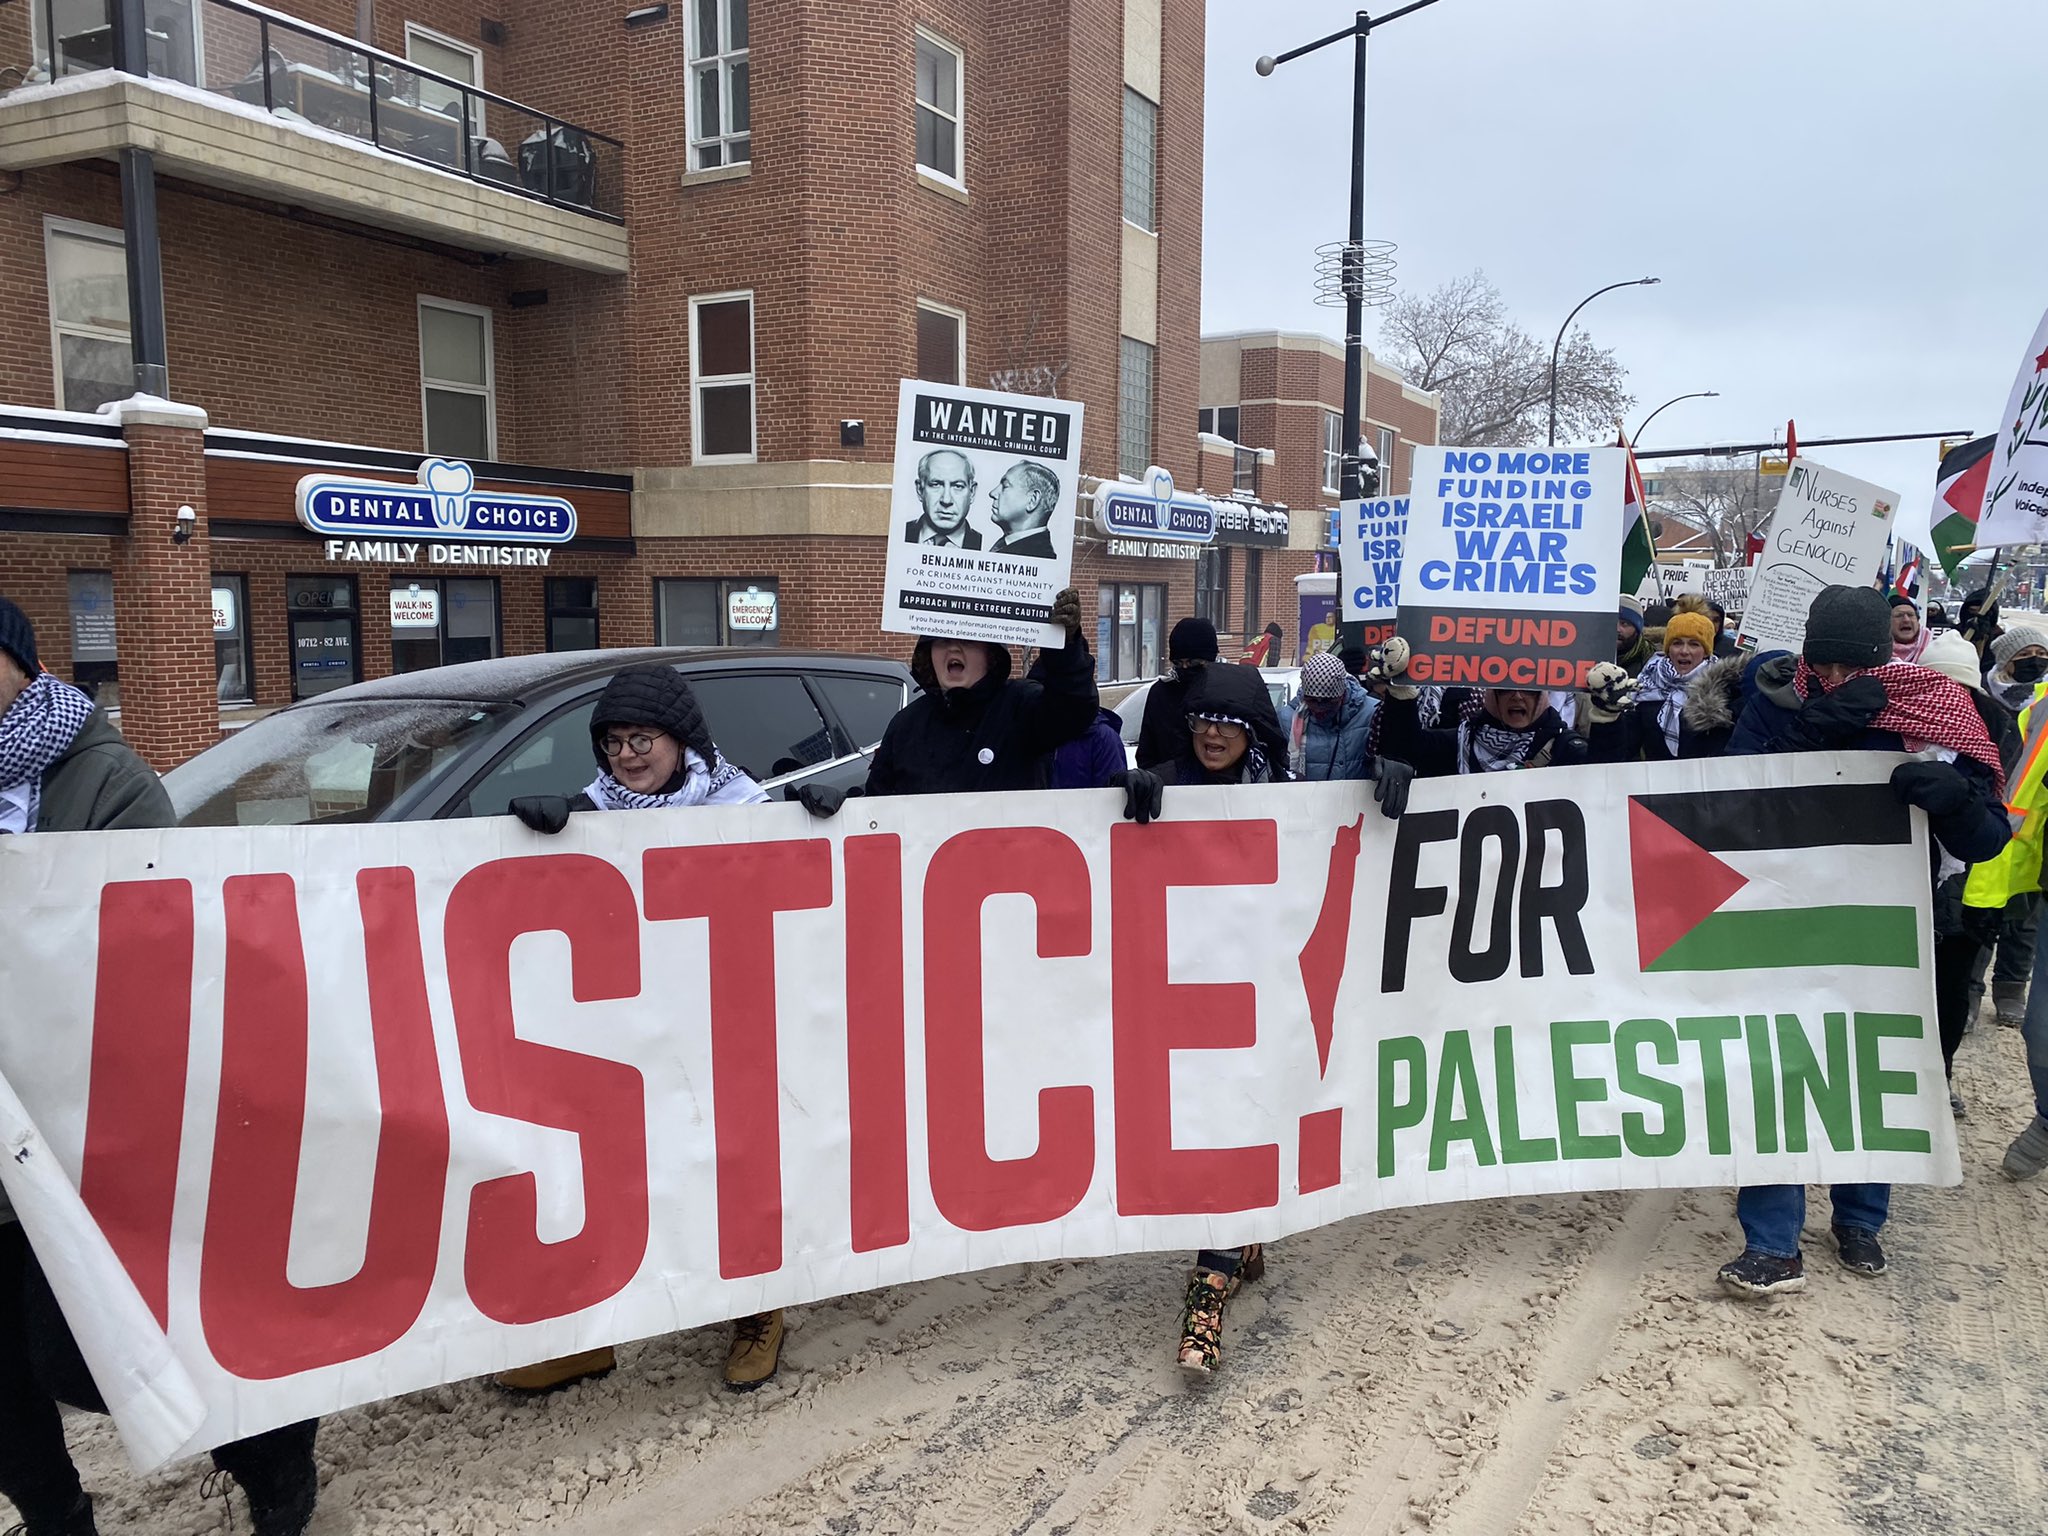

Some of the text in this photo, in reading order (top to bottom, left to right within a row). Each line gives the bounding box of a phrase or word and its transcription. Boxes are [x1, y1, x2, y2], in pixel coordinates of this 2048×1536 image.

[929, 400, 1057, 444] WANTED
[920, 430, 1062, 455] BY THE INTERNATIONAL CRIMINAL COURT
[1444, 452, 1590, 474] NO MORE
[1438, 479, 1592, 500] FUNDING
[330, 496, 558, 528] DENTAL CHOICE
[1114, 504, 1208, 530] DENTAL CHOICE
[1360, 501, 1390, 520] NO
[1442, 502, 1583, 530] ISRAELI
[1800, 507, 1856, 539] Against
[327, 540, 552, 566] FAMILY DENTISTRY
[1111, 539, 1201, 560] FAMILY DENTISTRY
[1363, 538, 1404, 562] ISR
[1455, 531, 1568, 562] WAR
[1776, 528, 1858, 574] GENOCIDE
[921, 554, 1039, 577] BENJAMIN NETANYAHU
[1662, 569, 1689, 582] PRIDE
[1734, 568, 1745, 580] TO
[906, 568, 1054, 590] FOR CRIMES AGAINST HUMANITY
[1419, 560, 1597, 595] CRIMES
[1720, 579, 1748, 592] HEROIC
[916, 580, 1042, 600] AND COMMITING GENOCIDE
[394, 601, 433, 610] WALK-INS
[394, 611, 434, 620] WELCOME
[732, 605, 774, 614] EMERGENCIES
[904, 595, 1050, 618] APPROACH WITH EXTREME CAUTION
[734, 616, 772, 624] WELCOME
[916, 616, 928, 624] you
[928, 616, 944, 624] have
[998, 624, 1030, 634] regarding
[1430, 615, 1577, 647] DEFUND
[298, 637, 318, 648] 10712
[324, 637, 334, 646] 82
[334, 636, 350, 647] AVE.
[956, 628, 978, 638] please
[978, 631, 1002, 640] contact
[1016, 634, 1036, 644] Hague
[1407, 653, 1596, 688] GENOCIDE
[1381, 798, 1595, 993] FOR
[1377, 1011, 1931, 1179] PALESTINE
